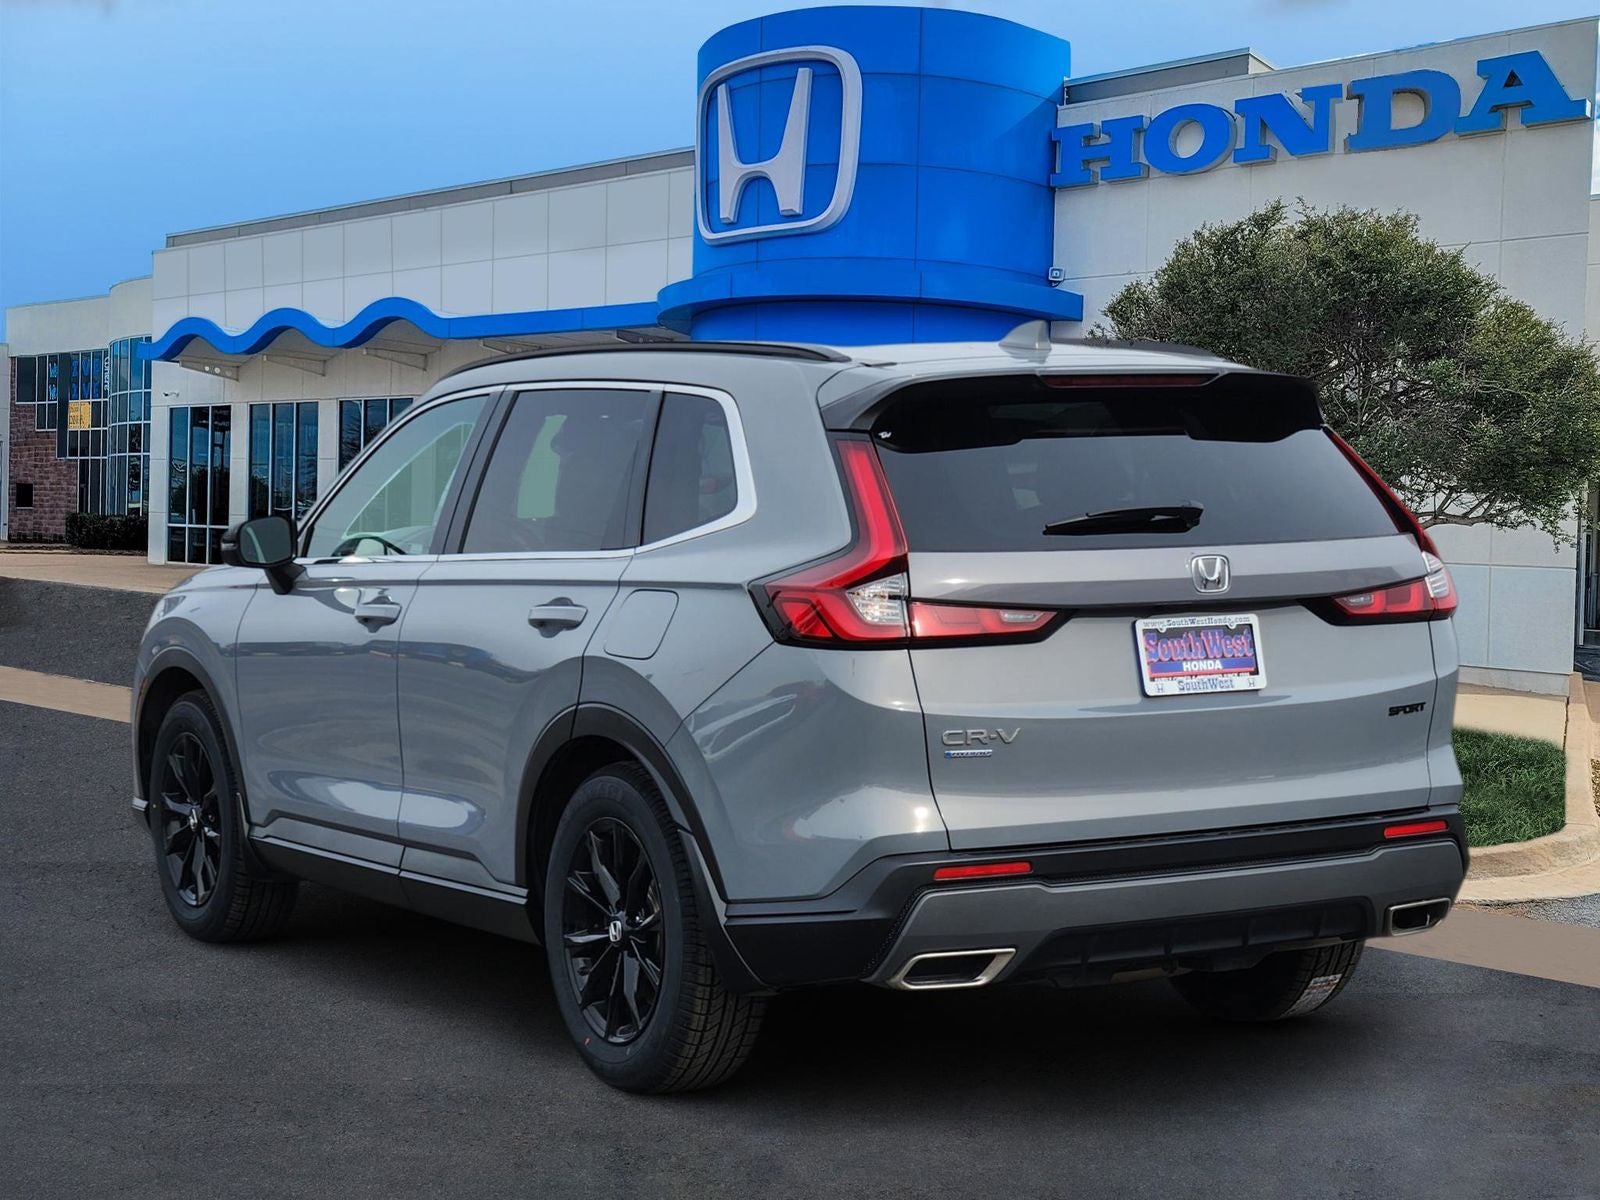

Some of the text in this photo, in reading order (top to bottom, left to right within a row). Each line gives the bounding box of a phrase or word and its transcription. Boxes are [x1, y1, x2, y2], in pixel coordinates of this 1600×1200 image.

[1051, 50, 1592, 188] HONDA
[1182, 659, 1224, 672] HONDA
[1388, 701, 1426, 717] SPORT
[942, 727, 1021, 746] CR-V
